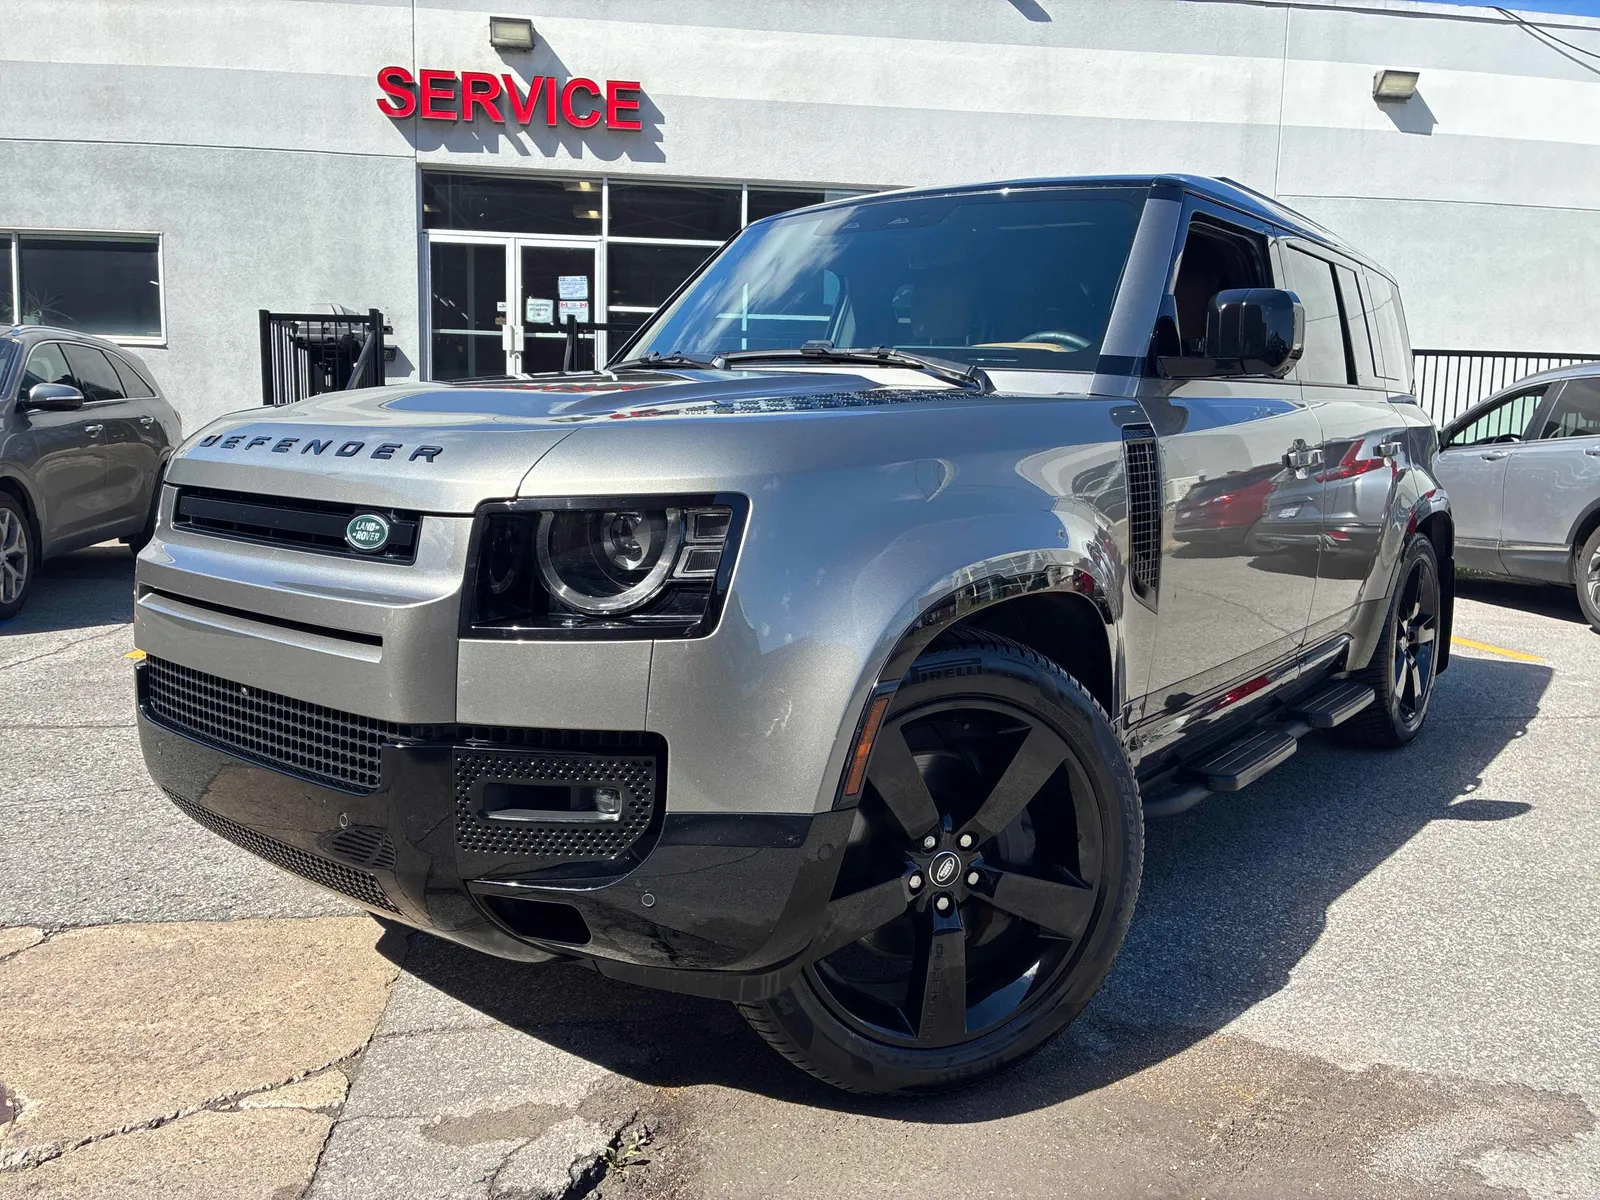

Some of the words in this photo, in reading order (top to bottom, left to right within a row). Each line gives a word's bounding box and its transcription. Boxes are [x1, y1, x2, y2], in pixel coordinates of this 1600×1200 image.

[376, 65, 643, 131] SERVICE
[198, 434, 444, 463] DEFENDER
[909, 658, 984, 685] PIRELLI
